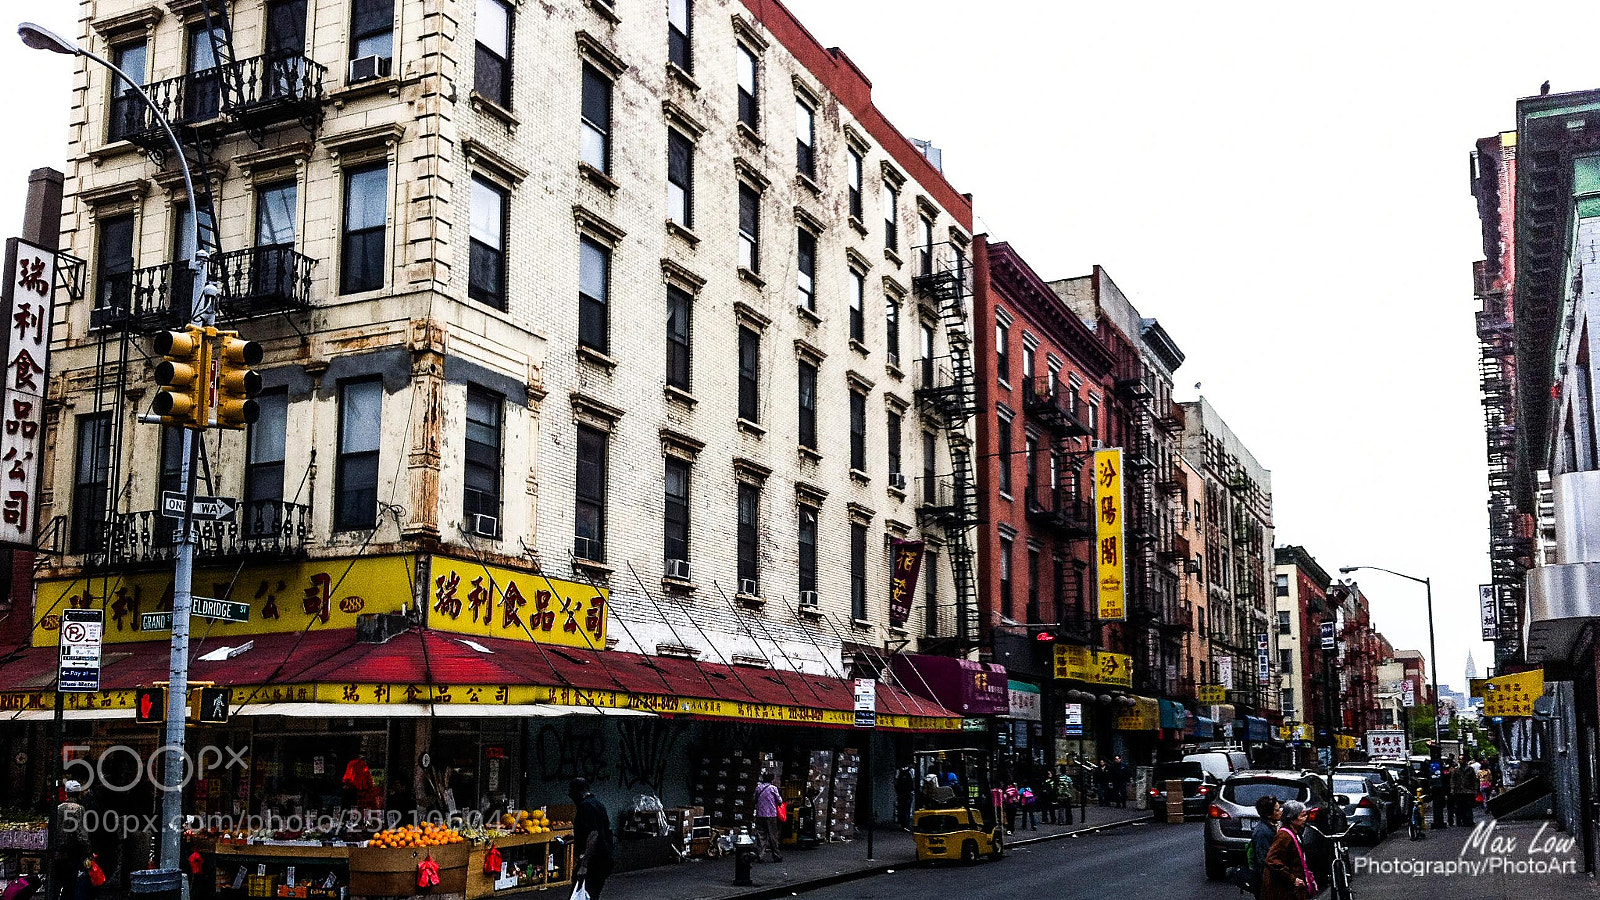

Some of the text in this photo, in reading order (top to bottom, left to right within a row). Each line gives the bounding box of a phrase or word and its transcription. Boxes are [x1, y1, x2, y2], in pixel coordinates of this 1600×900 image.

[3, 257, 49, 534] 瑞利食品公司
[202, 503, 225, 515] WAY
[192, 599, 232, 618] ELDRIDGE
[342, 597, 363, 613] 288
[433, 569, 607, 642] 瑞利食品公司
[142, 615, 166, 629] GRAND
[342, 683, 510, 705] 瑞利食品公司
